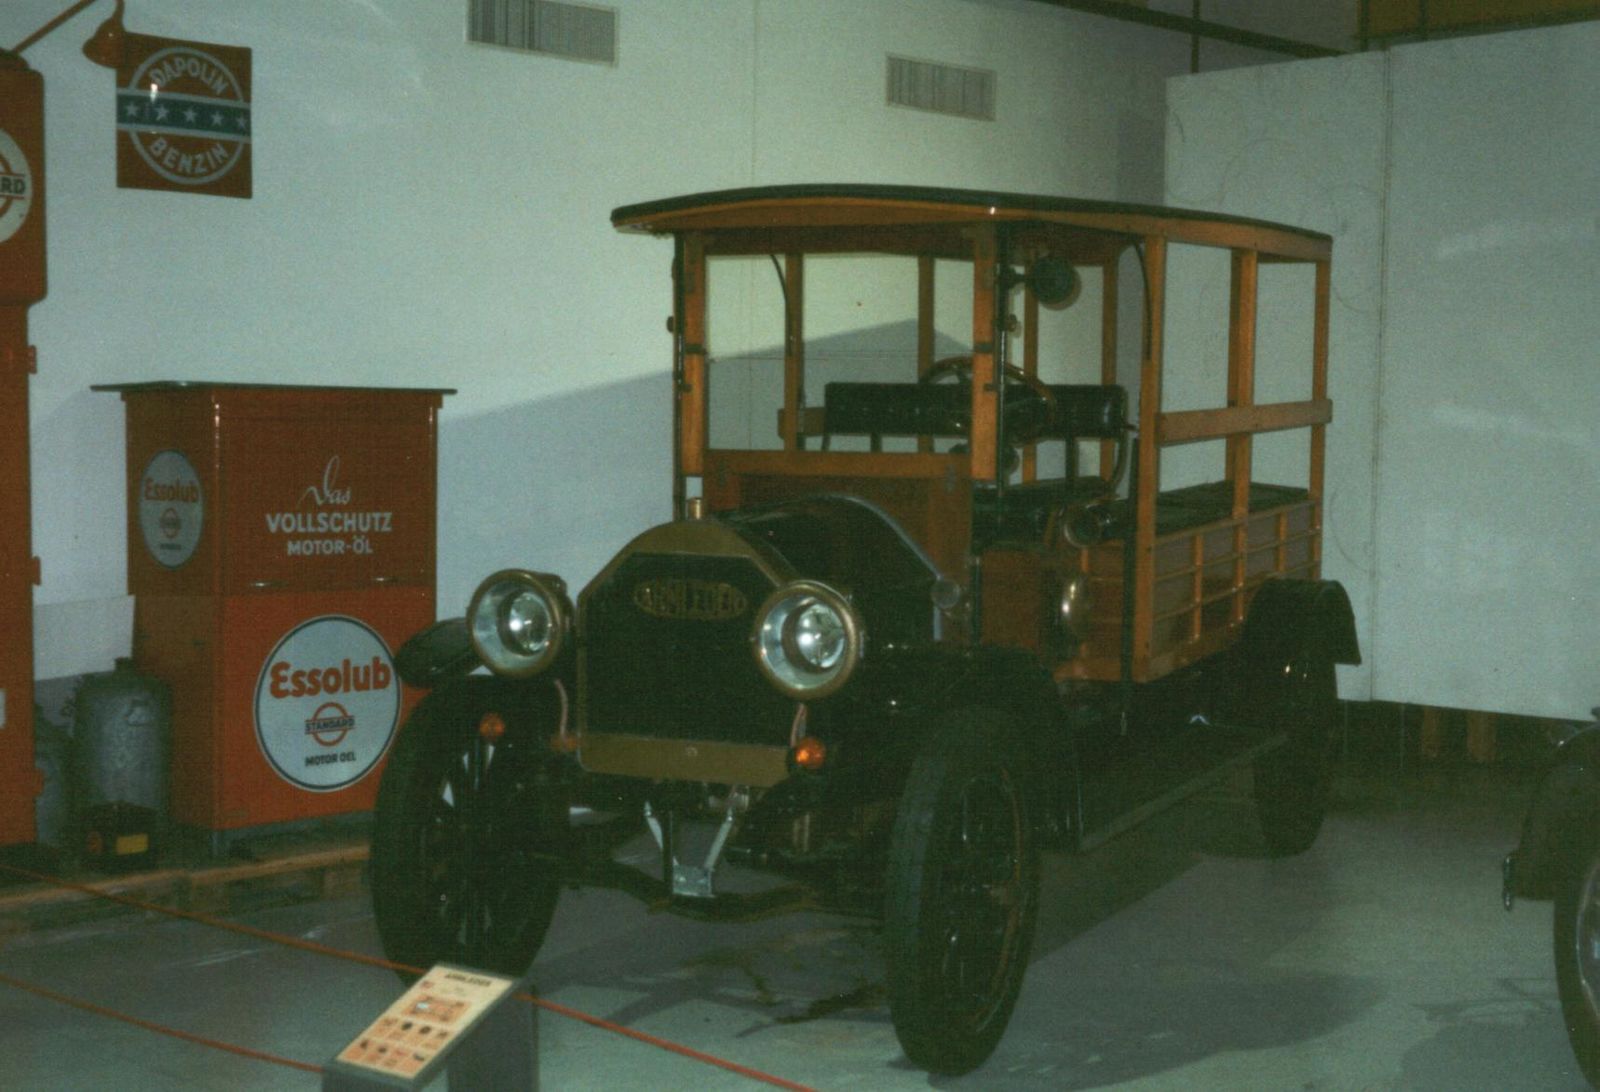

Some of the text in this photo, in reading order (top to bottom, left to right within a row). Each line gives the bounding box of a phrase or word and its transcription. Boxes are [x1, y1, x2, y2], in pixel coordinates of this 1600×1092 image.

[150, 57, 229, 95] DAPOLIN
[151, 137, 229, 174] BENZIN
[265, 511, 393, 534] VOLLSCHUTZ
[286, 535, 374, 556] MOTOR-ÖL
[270, 656, 391, 698] Essolub
[305, 717, 355, 732] STANDARD
[305, 753, 339, 767] MOTOR
